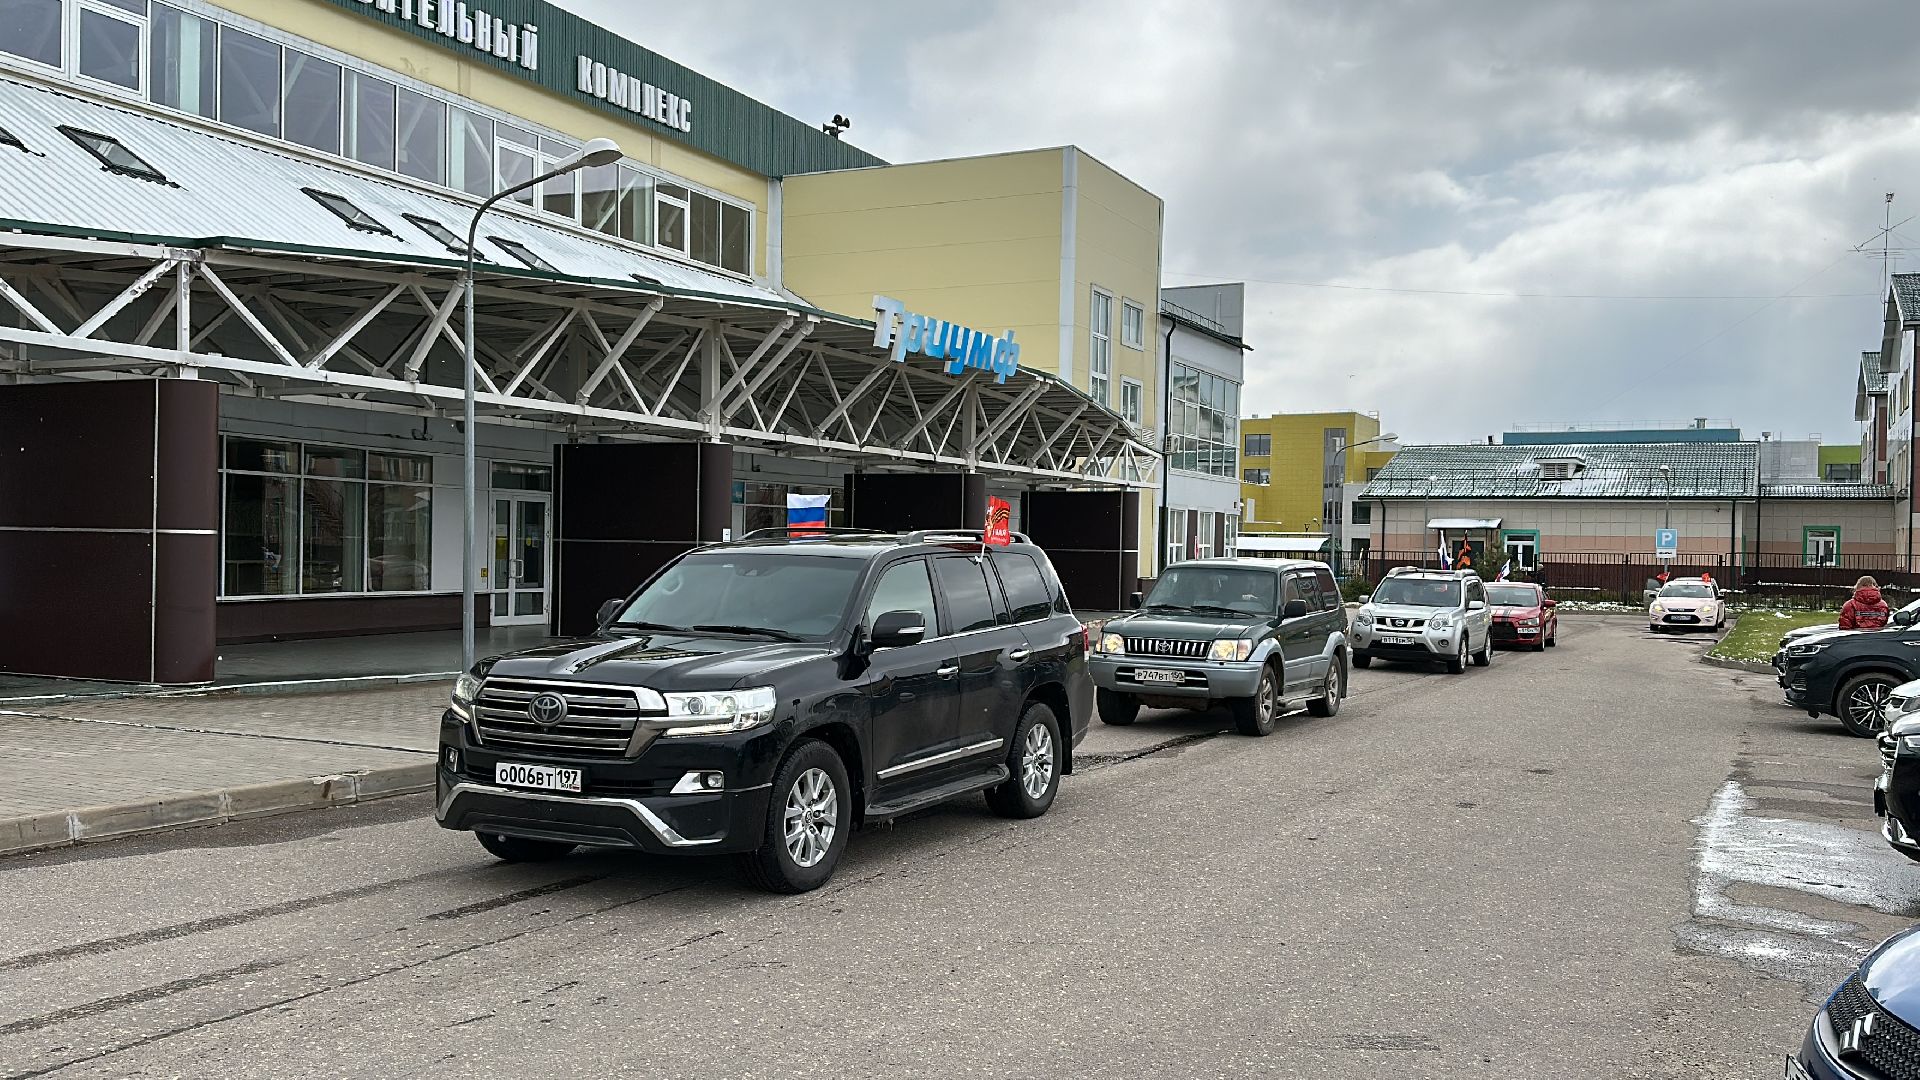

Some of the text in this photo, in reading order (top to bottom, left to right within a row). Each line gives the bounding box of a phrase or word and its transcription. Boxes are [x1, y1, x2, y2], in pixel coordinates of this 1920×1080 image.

[358, 0, 692, 133] ЕЛЬНЫЙ КОМПЛЕКС
[872, 294, 1020, 385] Триумф
[1661, 531, 1673, 546] P
[499, 765, 578, 787] О006ВТ 197
